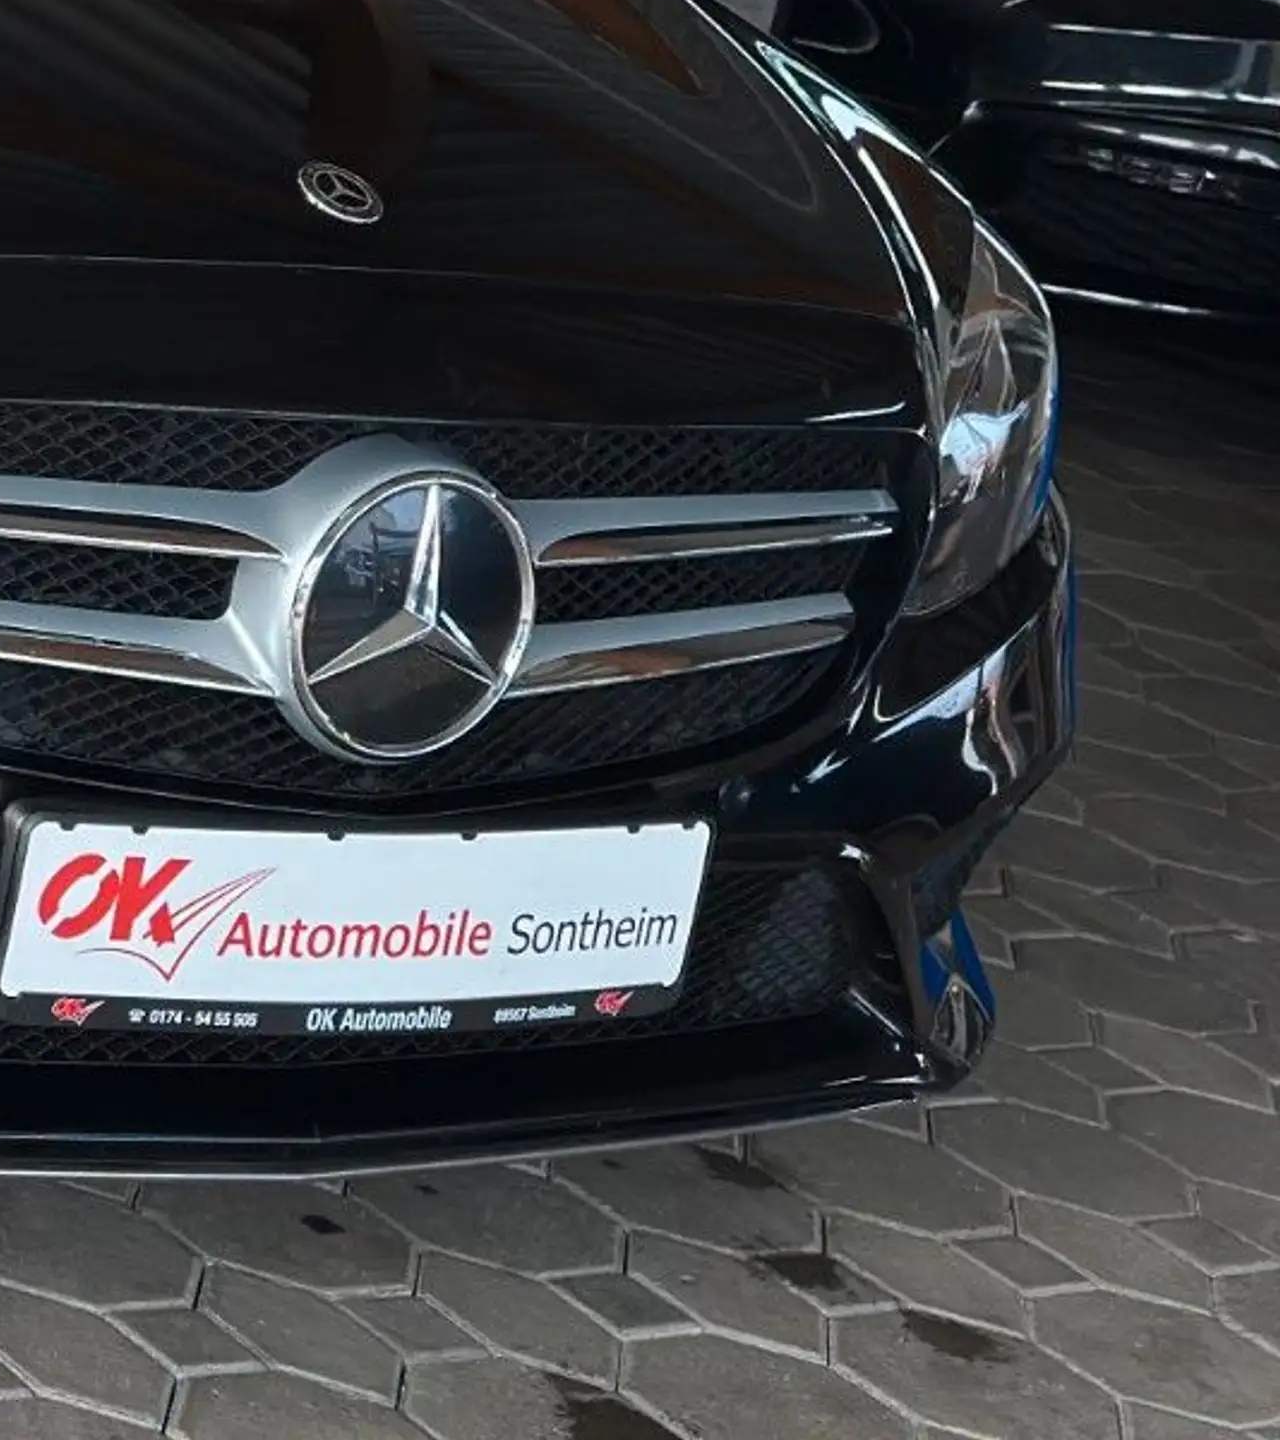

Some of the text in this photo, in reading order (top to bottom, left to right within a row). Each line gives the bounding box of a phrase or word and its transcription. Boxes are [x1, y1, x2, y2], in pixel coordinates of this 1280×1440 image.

[38, 853, 678, 958] OK Automobile Sontheim
[149, 1009, 184, 1025] 0174
[306, 1007, 338, 1031] OK
[340, 1006, 453, 1031] Automobile
